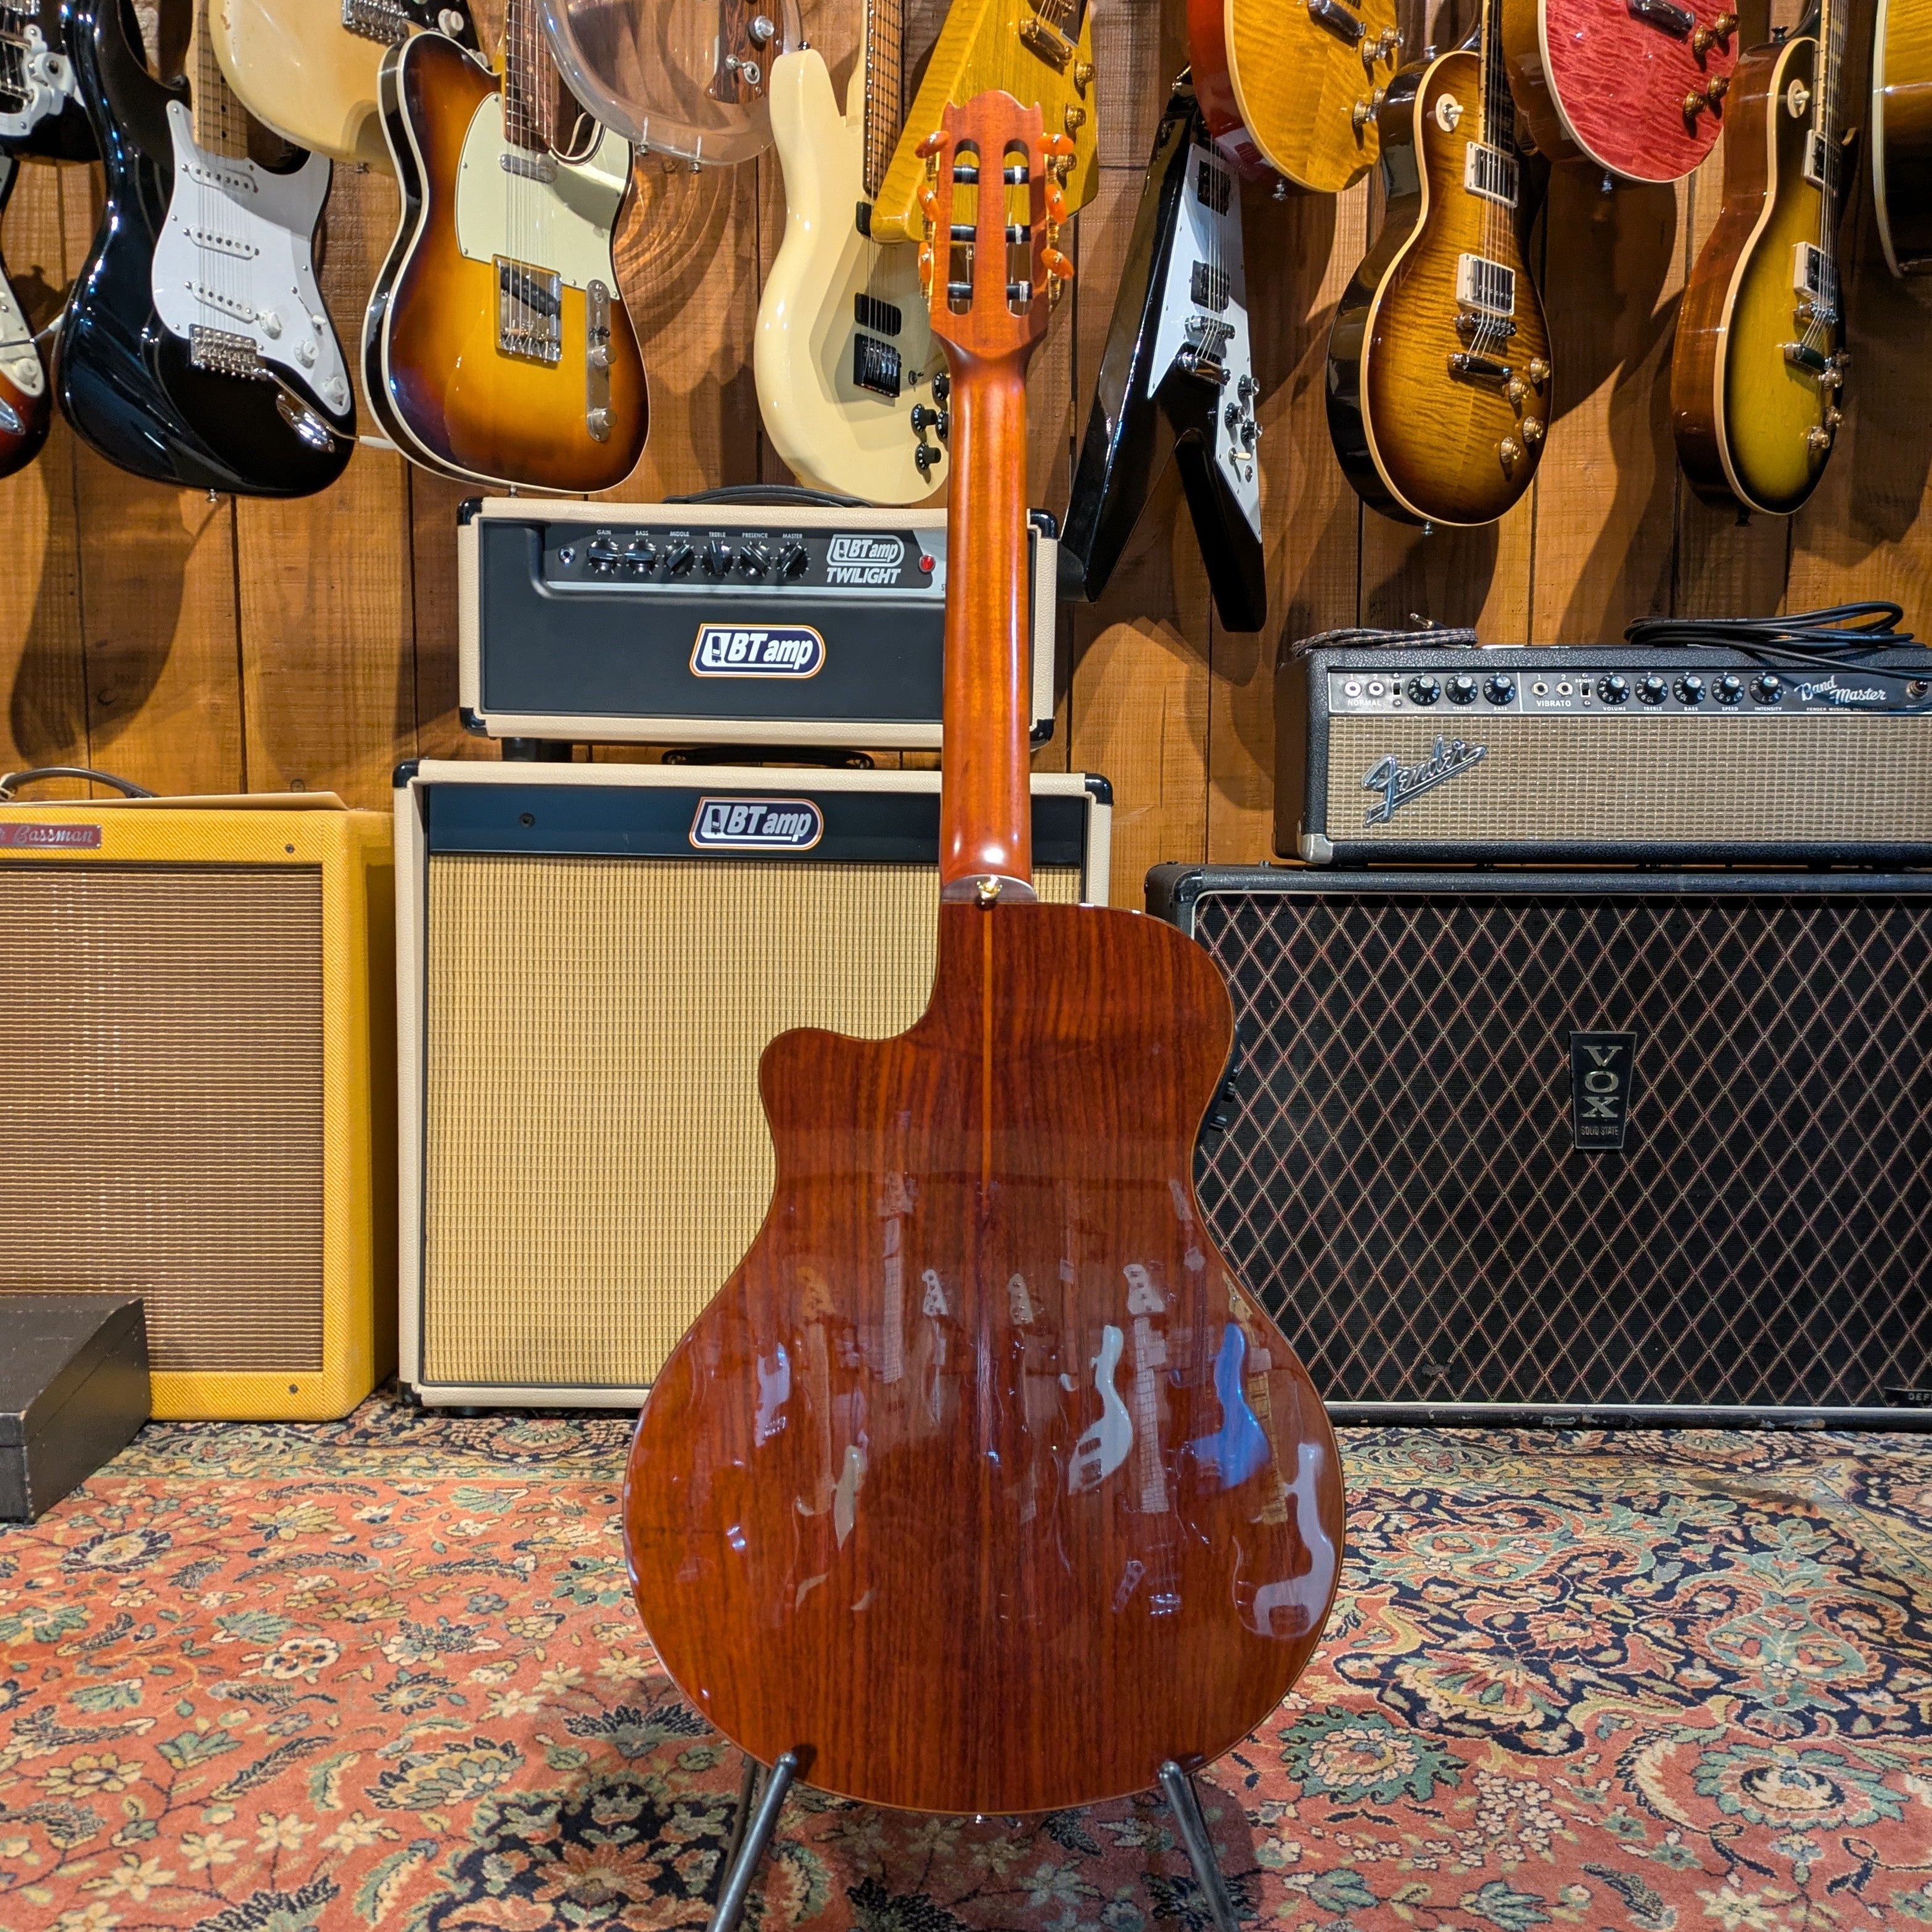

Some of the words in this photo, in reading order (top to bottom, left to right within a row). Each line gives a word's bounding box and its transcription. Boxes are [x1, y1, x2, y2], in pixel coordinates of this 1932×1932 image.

[826, 567, 902, 584] TWILIGHT
[1794, 674, 1838, 701] Band
[1829, 688, 1886, 704] Master
[1361, 734, 1487, 828] Fender
[12, 824, 92, 845] Bassman
[1581, 1045, 1623, 1118] VOX
[1581, 1125, 1599, 1135] SOLID
[1601, 1125, 1619, 1135] STATE
